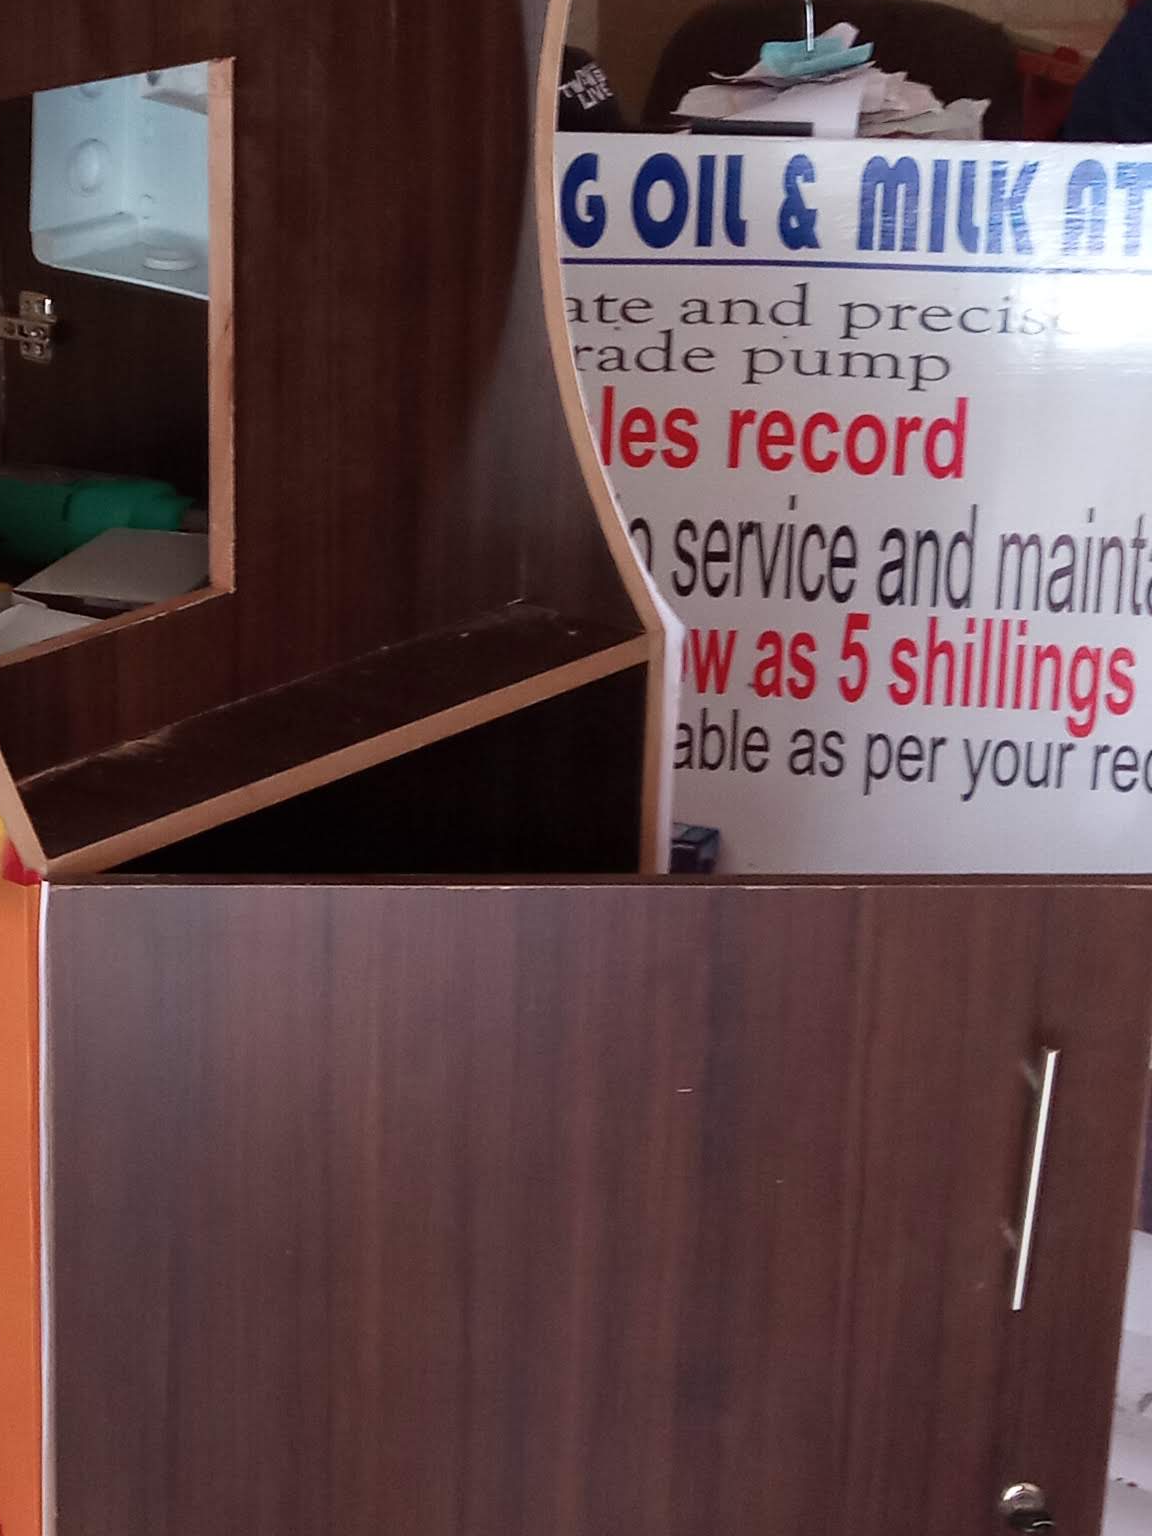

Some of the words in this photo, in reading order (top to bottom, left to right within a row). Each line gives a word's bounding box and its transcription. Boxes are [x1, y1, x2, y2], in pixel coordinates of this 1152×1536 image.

[631, 152, 747, 249] OIL
[778, 153, 822, 251] &
[856, 155, 1040, 255] MILK
[679, 282, 813, 327] and
[741, 346, 954, 392] pump
[600, 384, 700, 469] les
[727, 396, 969, 480] record
[671, 493, 859, 604] service
[876, 503, 979, 610] and
[752, 630, 818, 700] as
[838, 612, 871, 704] 5
[887, 615, 1137, 739] shillings
[788, 727, 846, 778] as
[862, 732, 948, 797] per
[960, 738, 1077, 802] your
